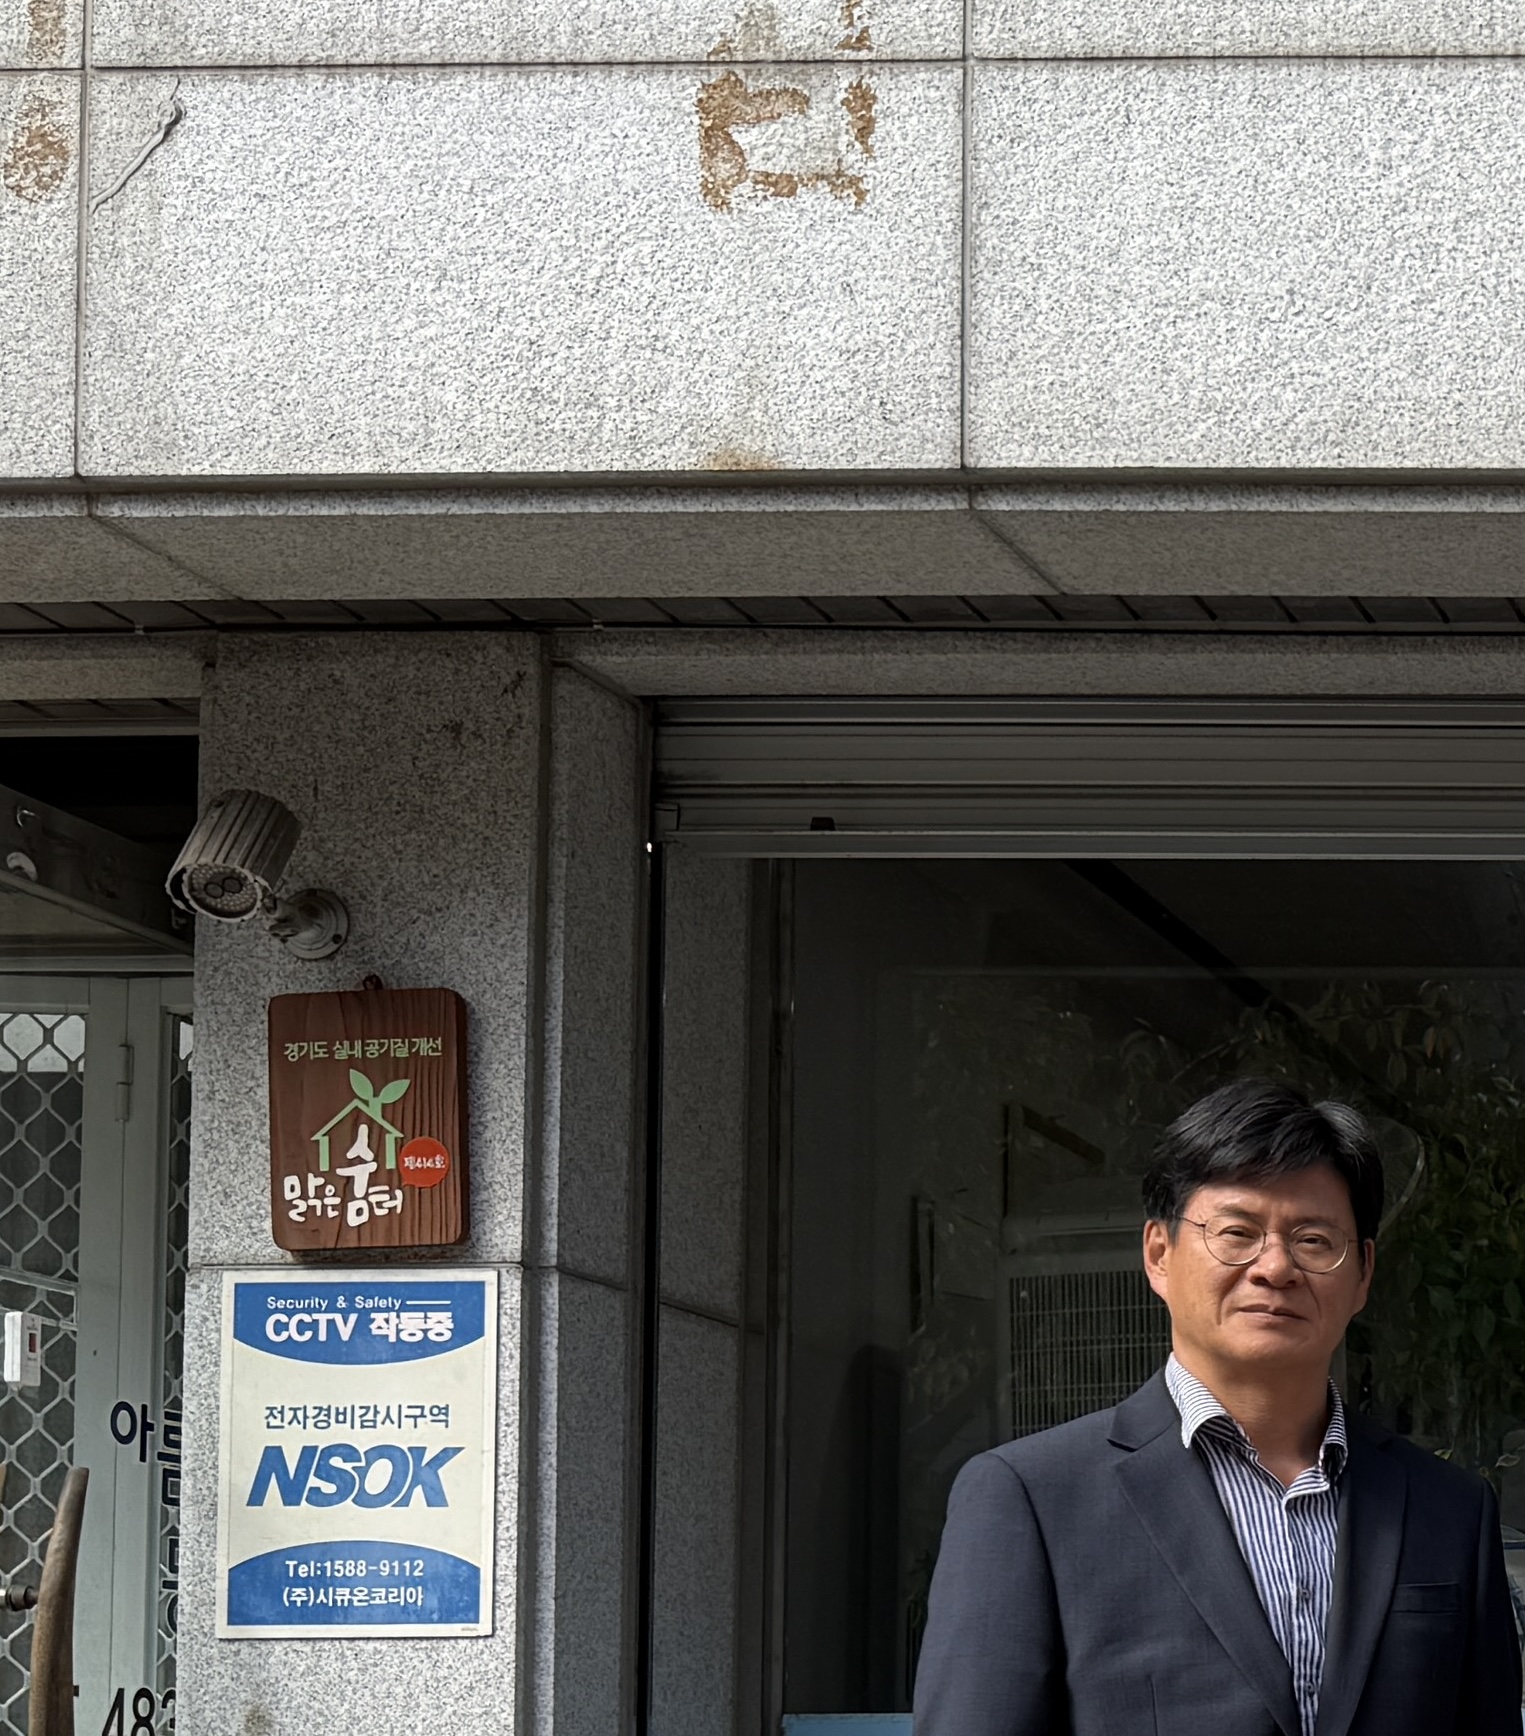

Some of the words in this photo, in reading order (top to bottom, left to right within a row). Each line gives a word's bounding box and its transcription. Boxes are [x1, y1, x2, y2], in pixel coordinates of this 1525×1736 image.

[284, 1040, 329, 1062] 경기도
[332, 1039, 362, 1059] 실내
[411, 1037, 442, 1057] 개선
[283, 1172, 341, 1222] 맑은
[267, 1296, 328, 1311] Security
[336, 1296, 348, 1309] &
[355, 1296, 402, 1311] Safety
[265, 1313, 358, 1342] CCTV
[369, 1312, 454, 1342] 작동중
[264, 1404, 450, 1430] 전자경비감시구역
[246, 1443, 466, 1509] NSOK
[286, 1560, 424, 1578] Tel:1588-9112
[283, 1587, 424, 1608] (주)시큐온코리아
